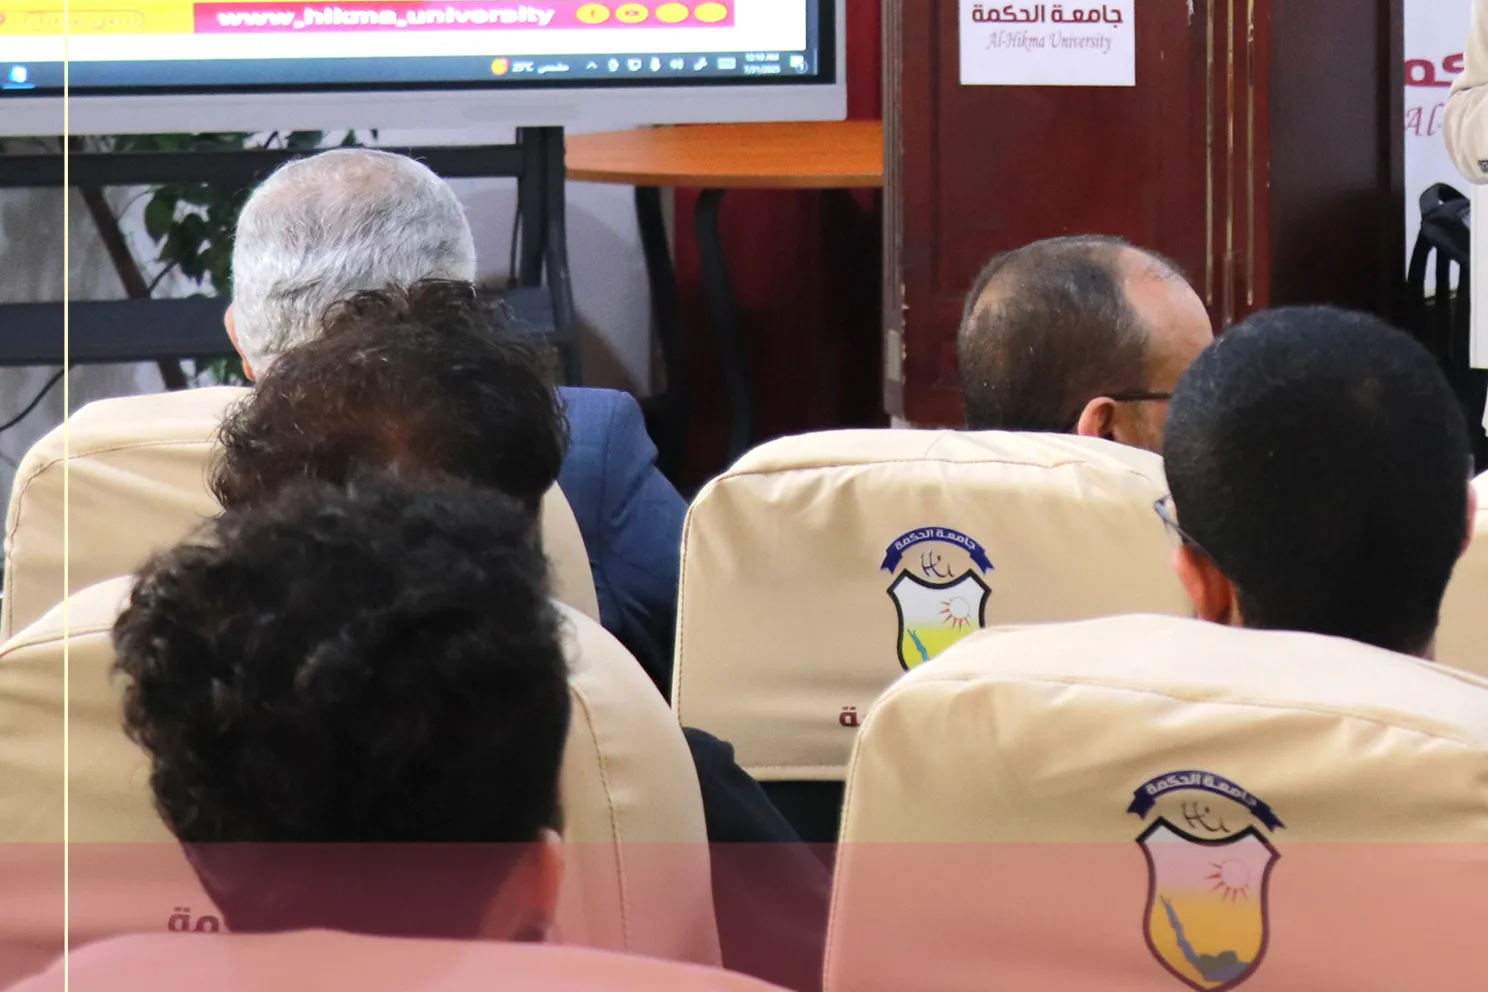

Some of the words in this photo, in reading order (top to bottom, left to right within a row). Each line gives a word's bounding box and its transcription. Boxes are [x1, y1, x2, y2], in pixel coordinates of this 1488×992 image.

[972, 4, 1045, 23] الحكمة
[1051, 4, 1123, 28] جامعة
[985, 29, 1045, 52] Al-Hikma
[1049, 30, 1113, 55] University
[894, 529, 934, 551] الحكمة
[936, 528, 976, 550] جامعة
[1145, 772, 1202, 796] الحكمة
